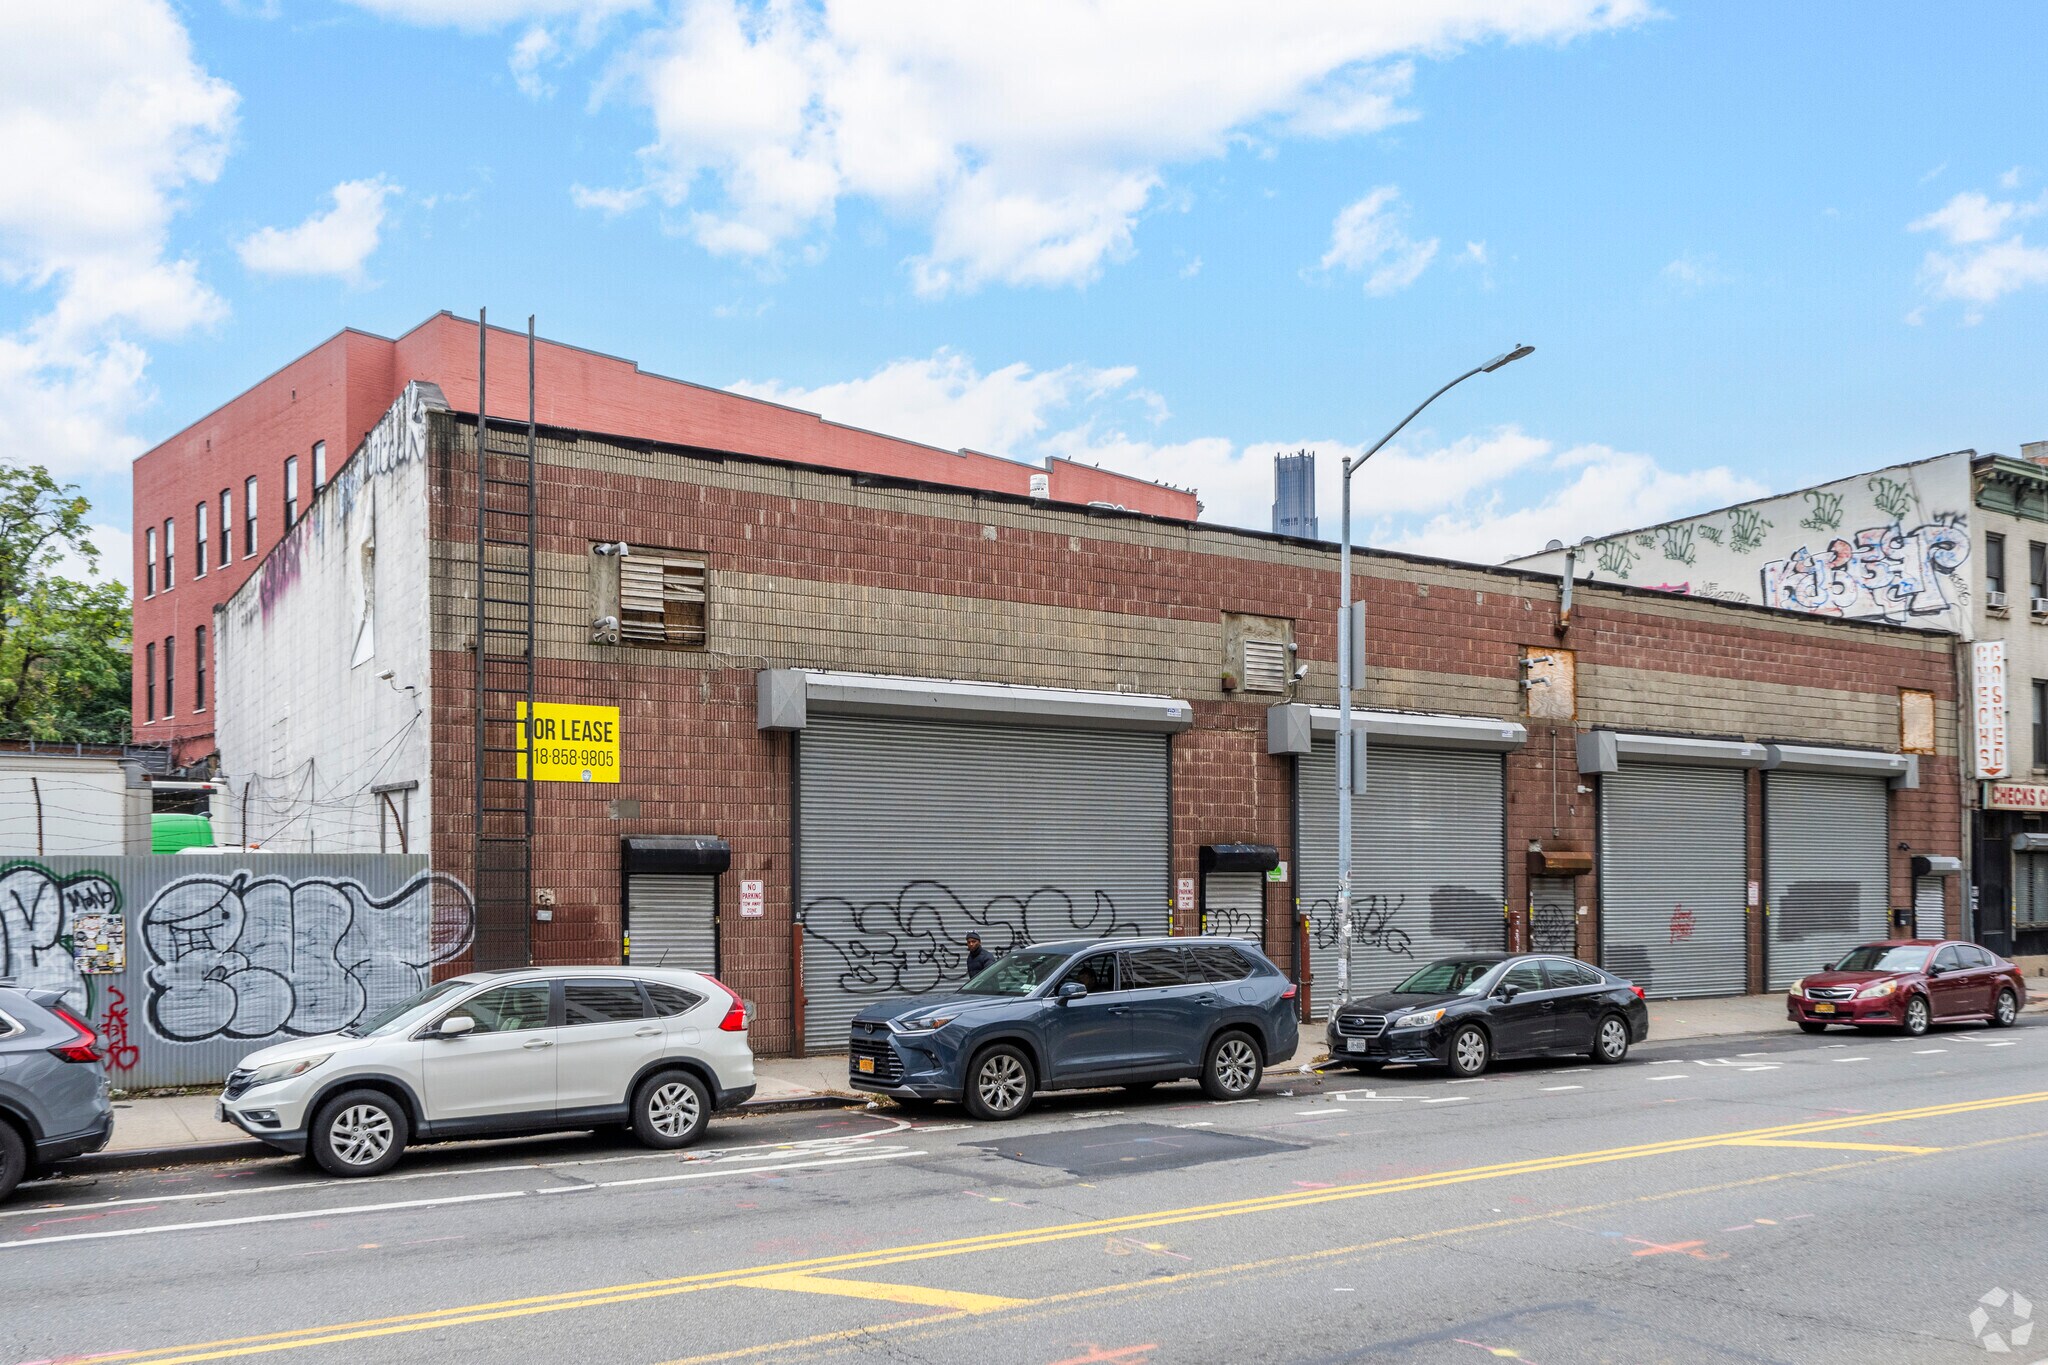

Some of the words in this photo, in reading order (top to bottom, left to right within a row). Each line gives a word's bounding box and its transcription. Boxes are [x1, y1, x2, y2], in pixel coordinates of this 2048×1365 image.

[524, 717, 556, 740] OR
[561, 719, 613, 743] LEASE
[1992, 785, 2036, 806] CHECKS
